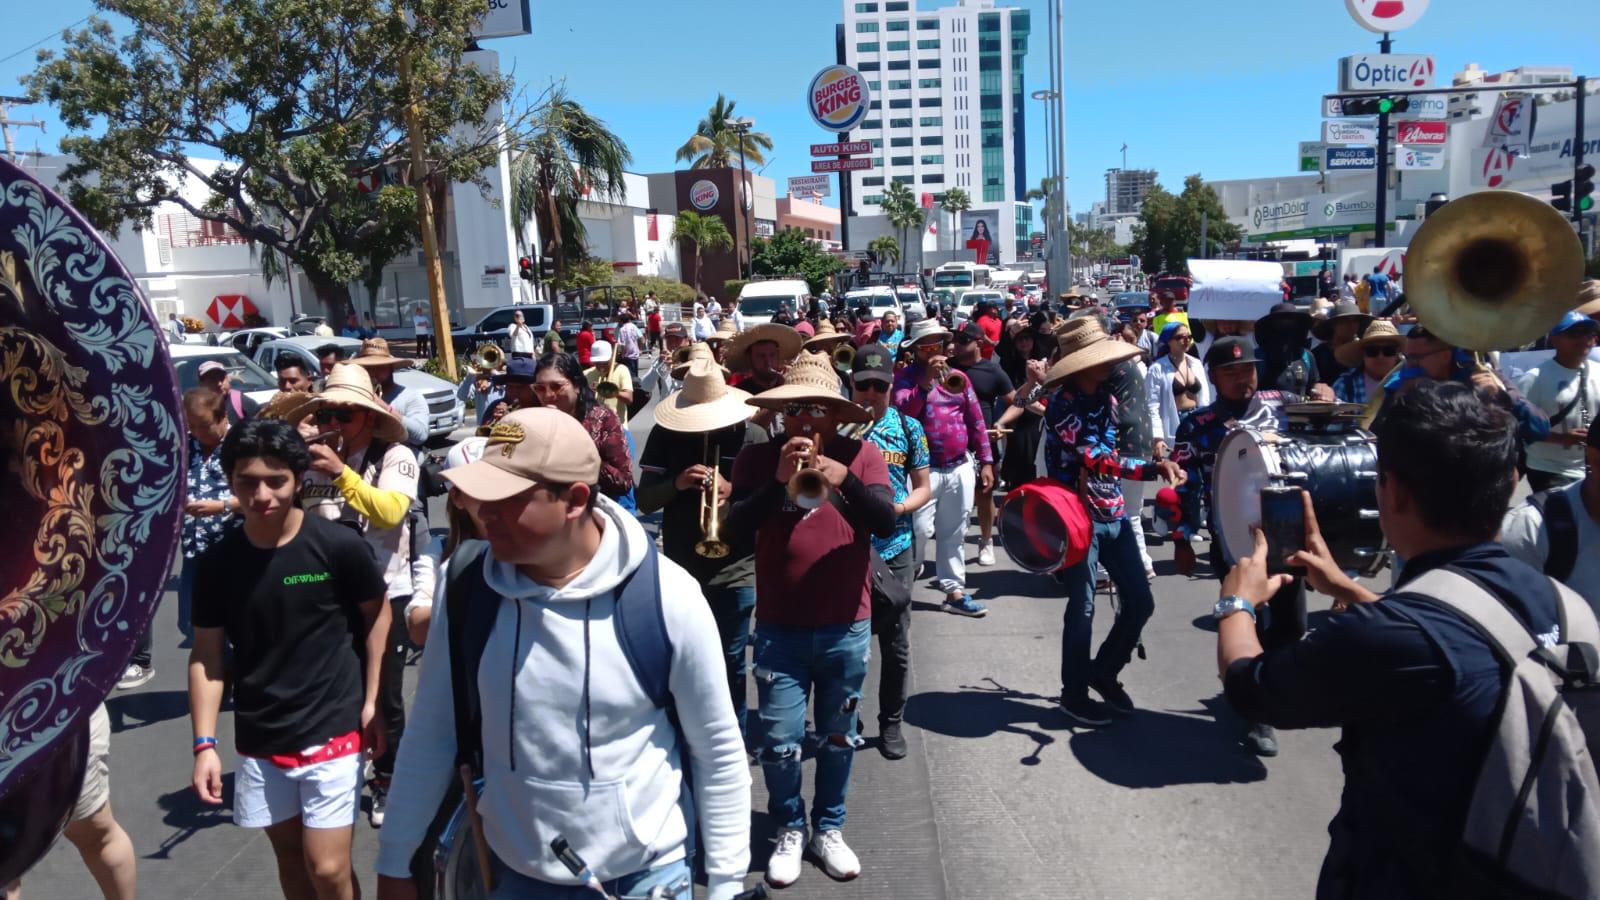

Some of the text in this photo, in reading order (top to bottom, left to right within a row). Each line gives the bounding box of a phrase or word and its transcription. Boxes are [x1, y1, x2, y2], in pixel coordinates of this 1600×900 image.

[815, 75, 858, 103] BURGER
[817, 85, 861, 118] KING
[842, 144, 868, 152] KING
[832, 161, 841, 169] DE
[843, 159, 868, 169] JUEGOS
[1330, 158, 1374, 166] SERVICIOS
